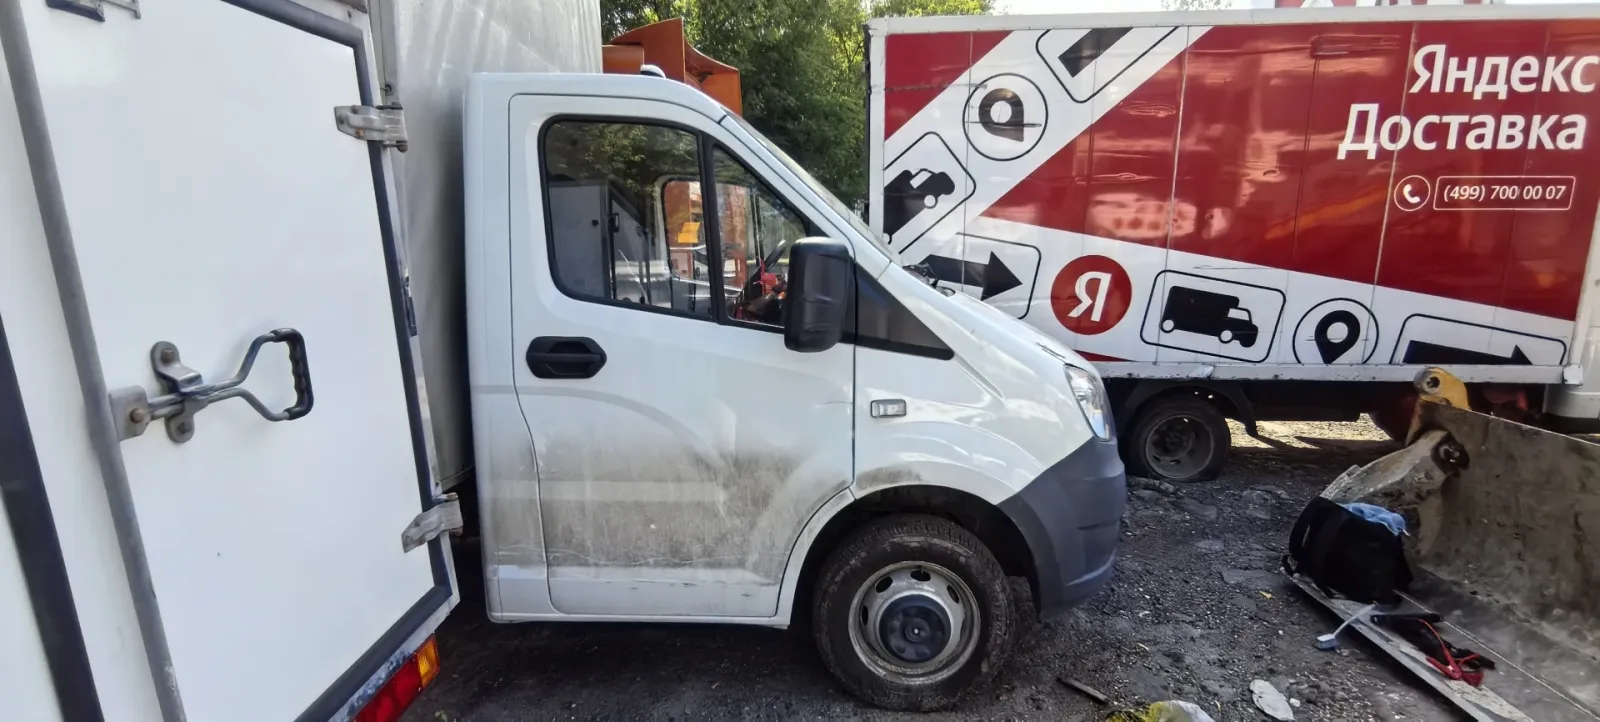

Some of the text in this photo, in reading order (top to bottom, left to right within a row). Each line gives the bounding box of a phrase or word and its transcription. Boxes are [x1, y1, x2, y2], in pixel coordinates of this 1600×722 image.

[1409, 44, 1599, 99] Яндекс
[1337, 103, 1587, 160] Доставка
[1444, 184, 1566, 202] (499) 700 00 07
[1067, 271, 1112, 322] Я
